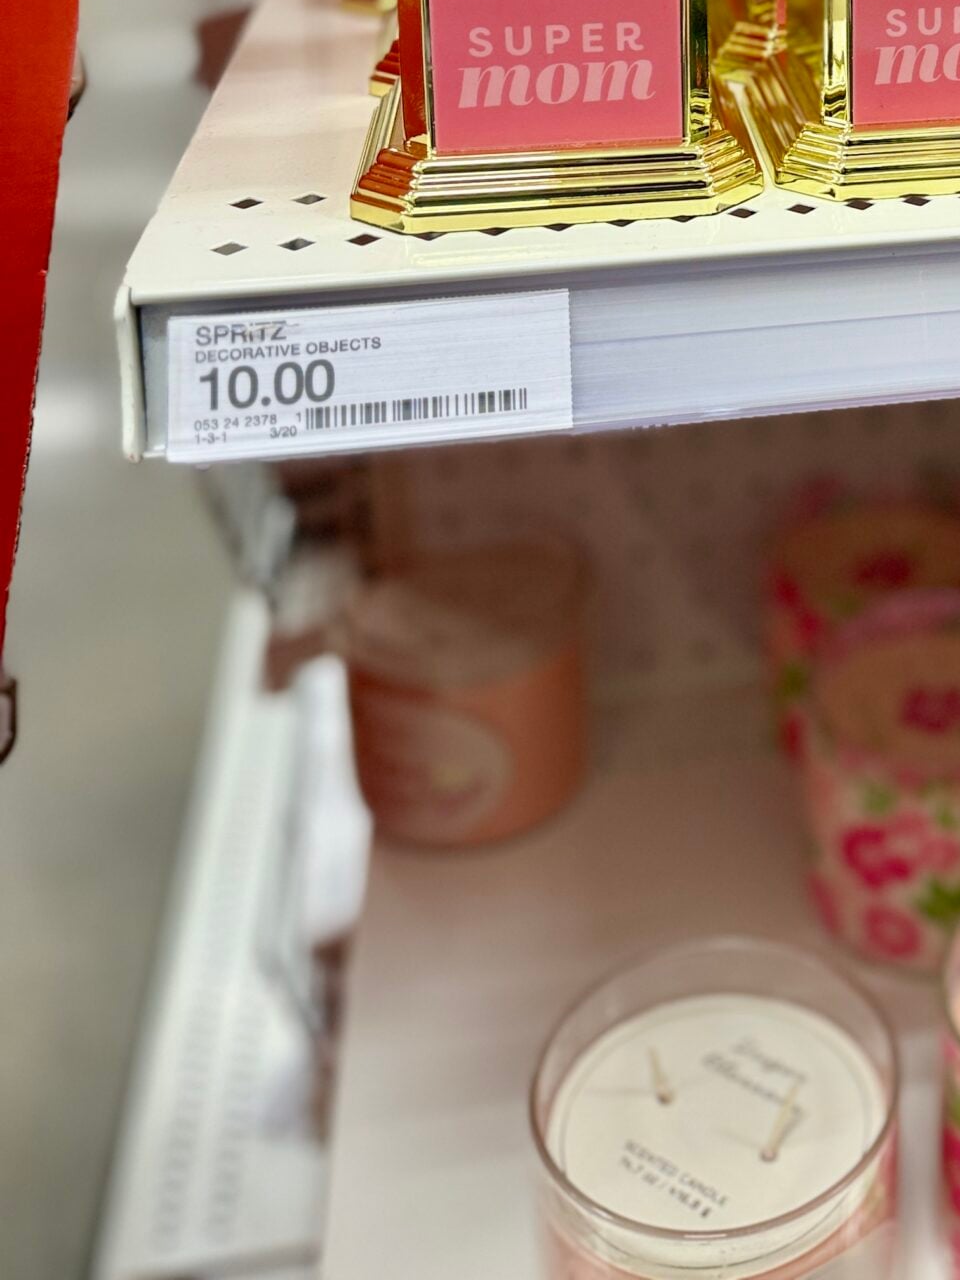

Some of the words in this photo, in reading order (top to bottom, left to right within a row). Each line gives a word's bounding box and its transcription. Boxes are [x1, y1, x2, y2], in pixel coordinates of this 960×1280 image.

[468, 21, 645, 58] SUPER
[457, 58, 656, 109] mom
[195, 320, 288, 346] SPRITZ
[195, 343, 300, 364] DECORATIVE
[305, 336, 382, 355] OBJECTS
[199, 358, 336, 411] 10.00
[194, 420, 219, 432] 053
[224, 417, 240, 429] 24
[245, 414, 278, 427] 2378
[194, 431, 228, 445] 1-3-1
[270, 425, 298, 439] 3/20
